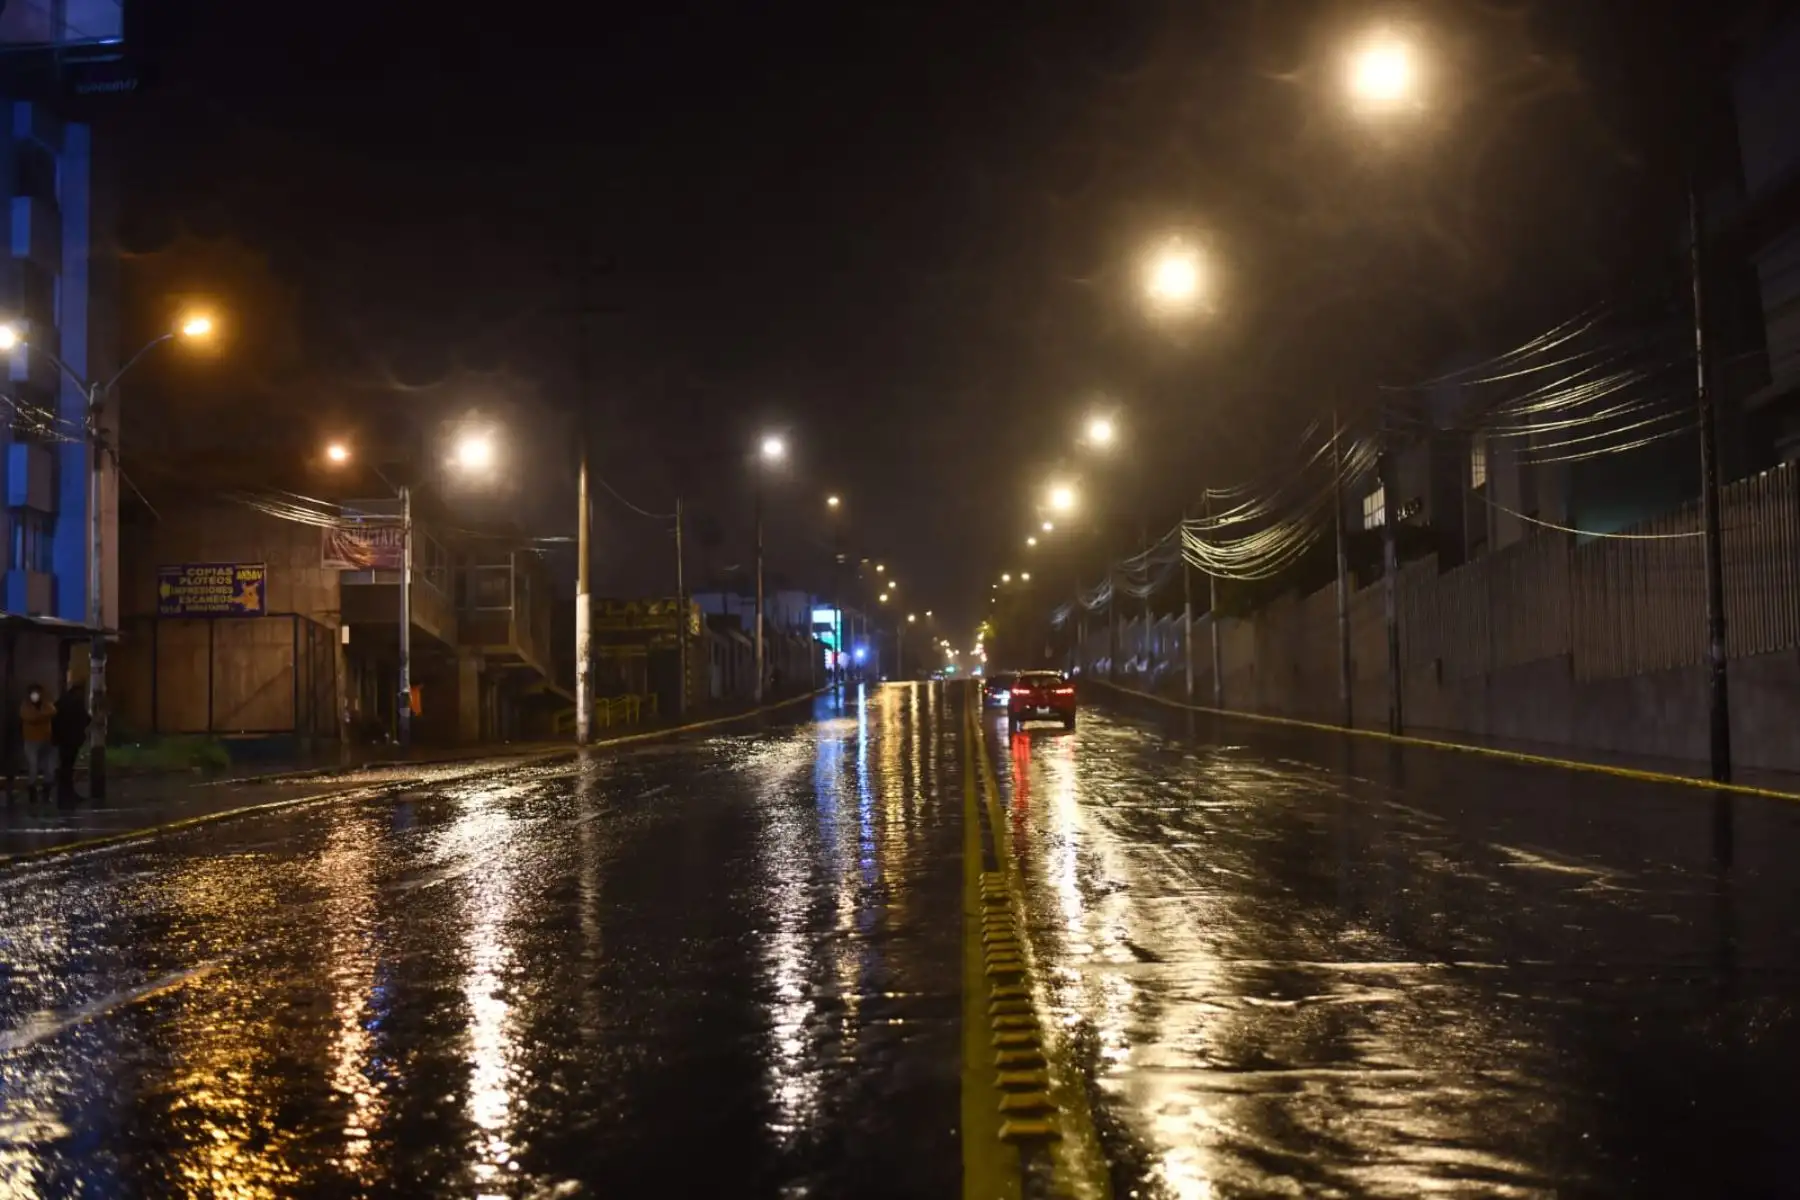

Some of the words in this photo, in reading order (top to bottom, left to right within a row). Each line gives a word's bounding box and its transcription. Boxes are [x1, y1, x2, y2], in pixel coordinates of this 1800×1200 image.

[186, 567, 234, 577] COPIAS
[179, 576, 233, 585] PLOTEOS
[171, 586, 234, 595] IMPRESIONES
[179, 595, 234, 604] ESCANEOS
